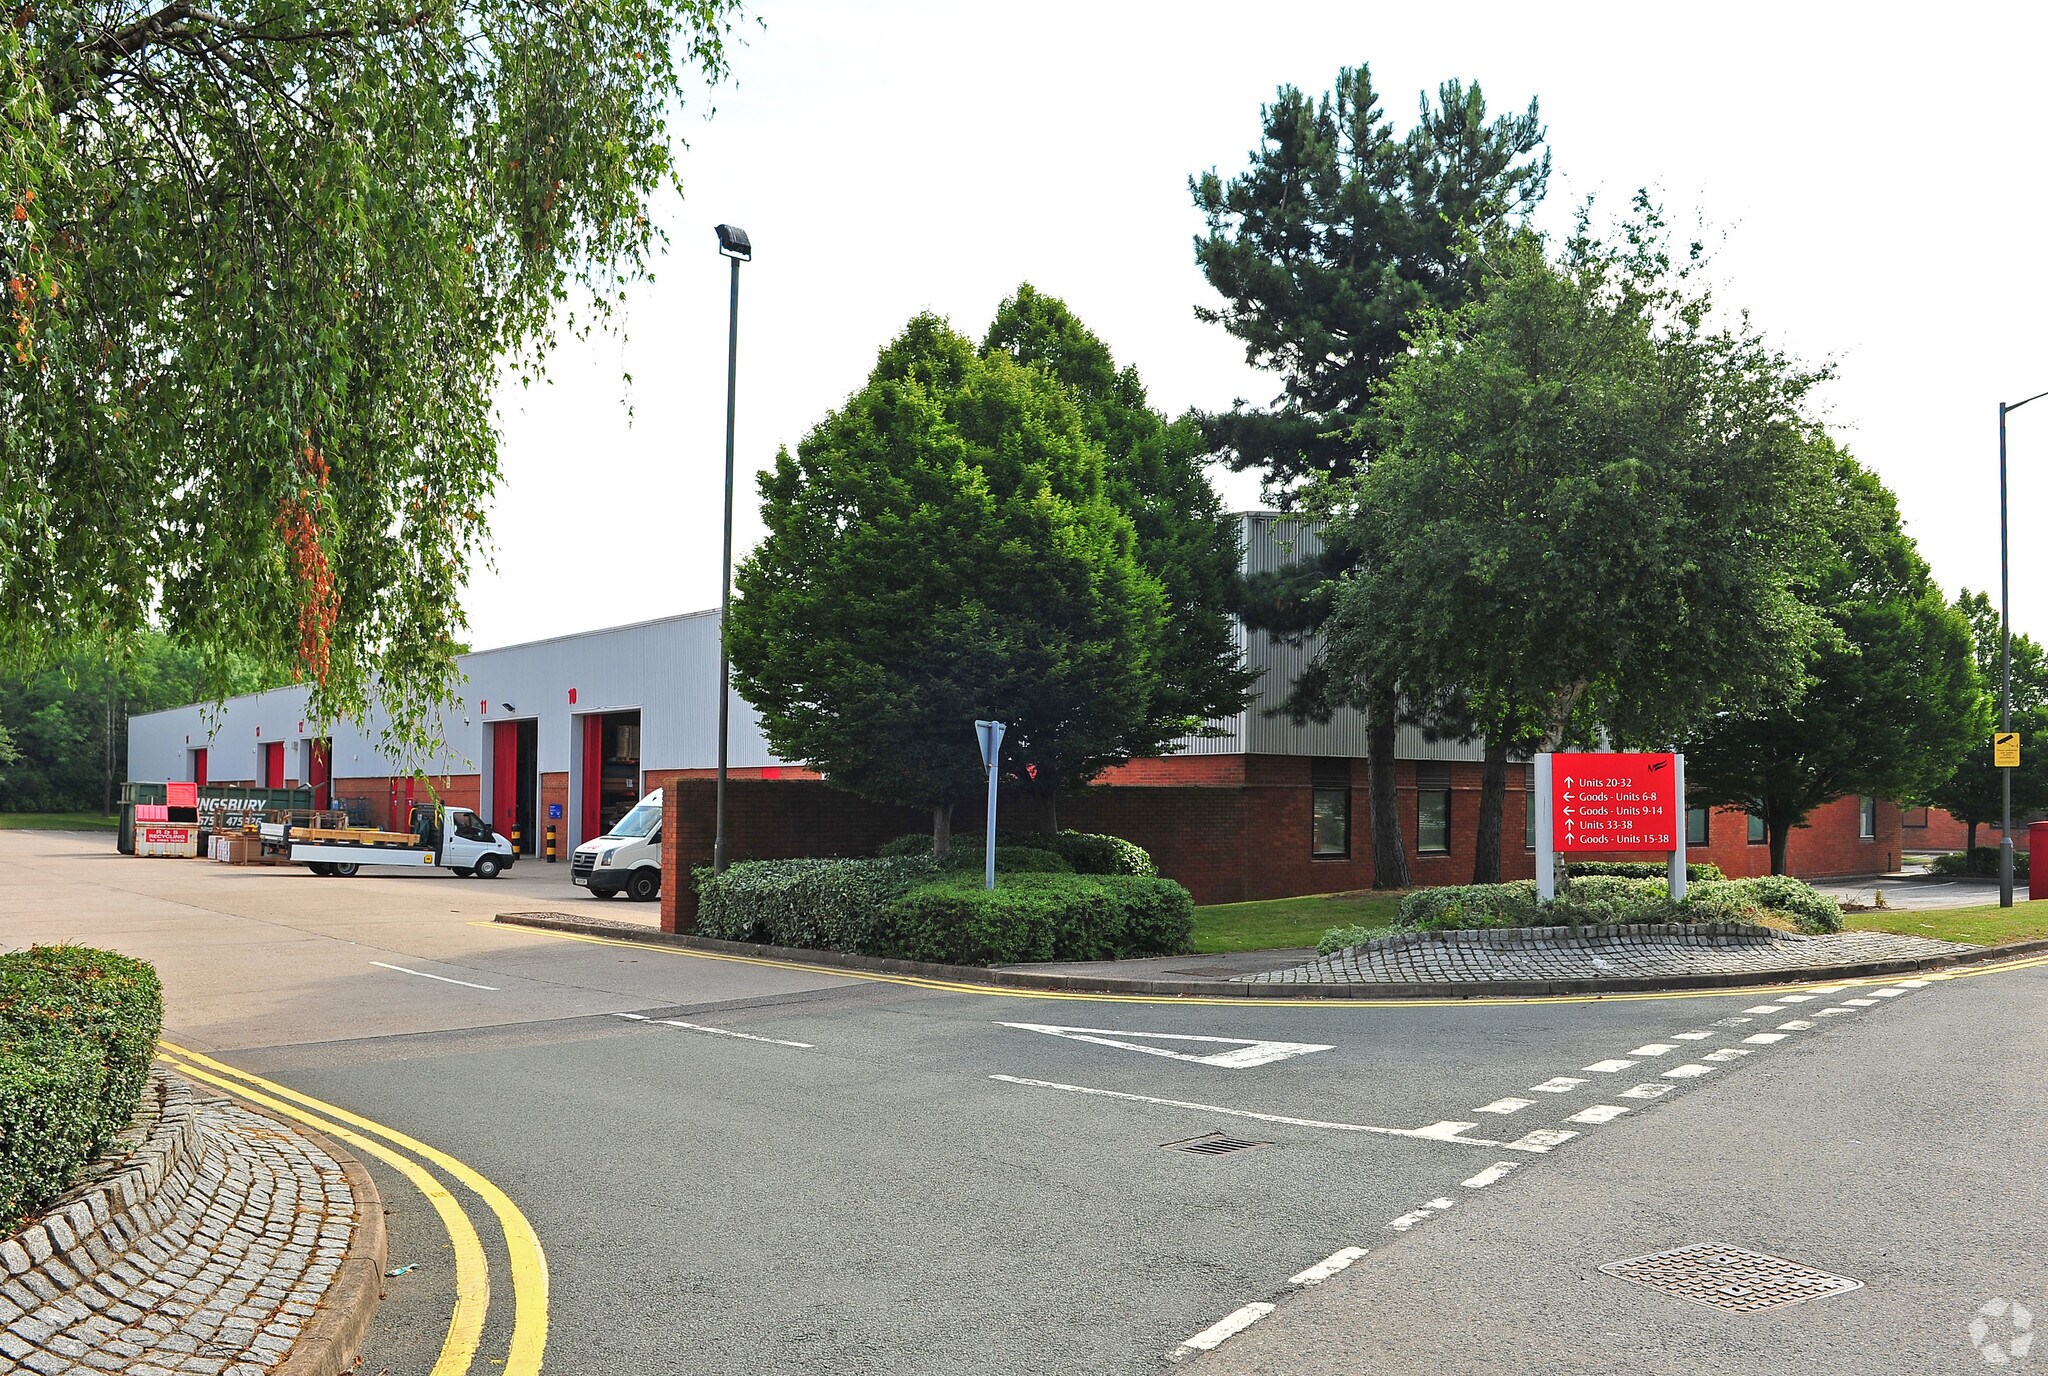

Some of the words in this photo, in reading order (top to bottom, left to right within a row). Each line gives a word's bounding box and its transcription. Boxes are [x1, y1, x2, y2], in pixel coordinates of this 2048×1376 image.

[568, 688, 577, 704] 10
[480, 700, 487, 714] 11
[1579, 778, 1603, 788] Units
[1605, 778, 1632, 788] 20-32
[1579, 791, 1609, 801] Goods
[1616, 791, 1640, 801] Units
[1642, 791, 1657, 801] 6-8
[1579, 805, 1609, 815] Goods
[1616, 805, 1640, 815] Units
[1642, 806, 1663, 815] 9-14
[1579, 820, 1604, 830] Units
[1606, 820, 1633, 830] 33-38
[1579, 834, 1609, 844] Goods
[1616, 834, 1641, 844] Units
[1644, 834, 1670, 844] 15-38
